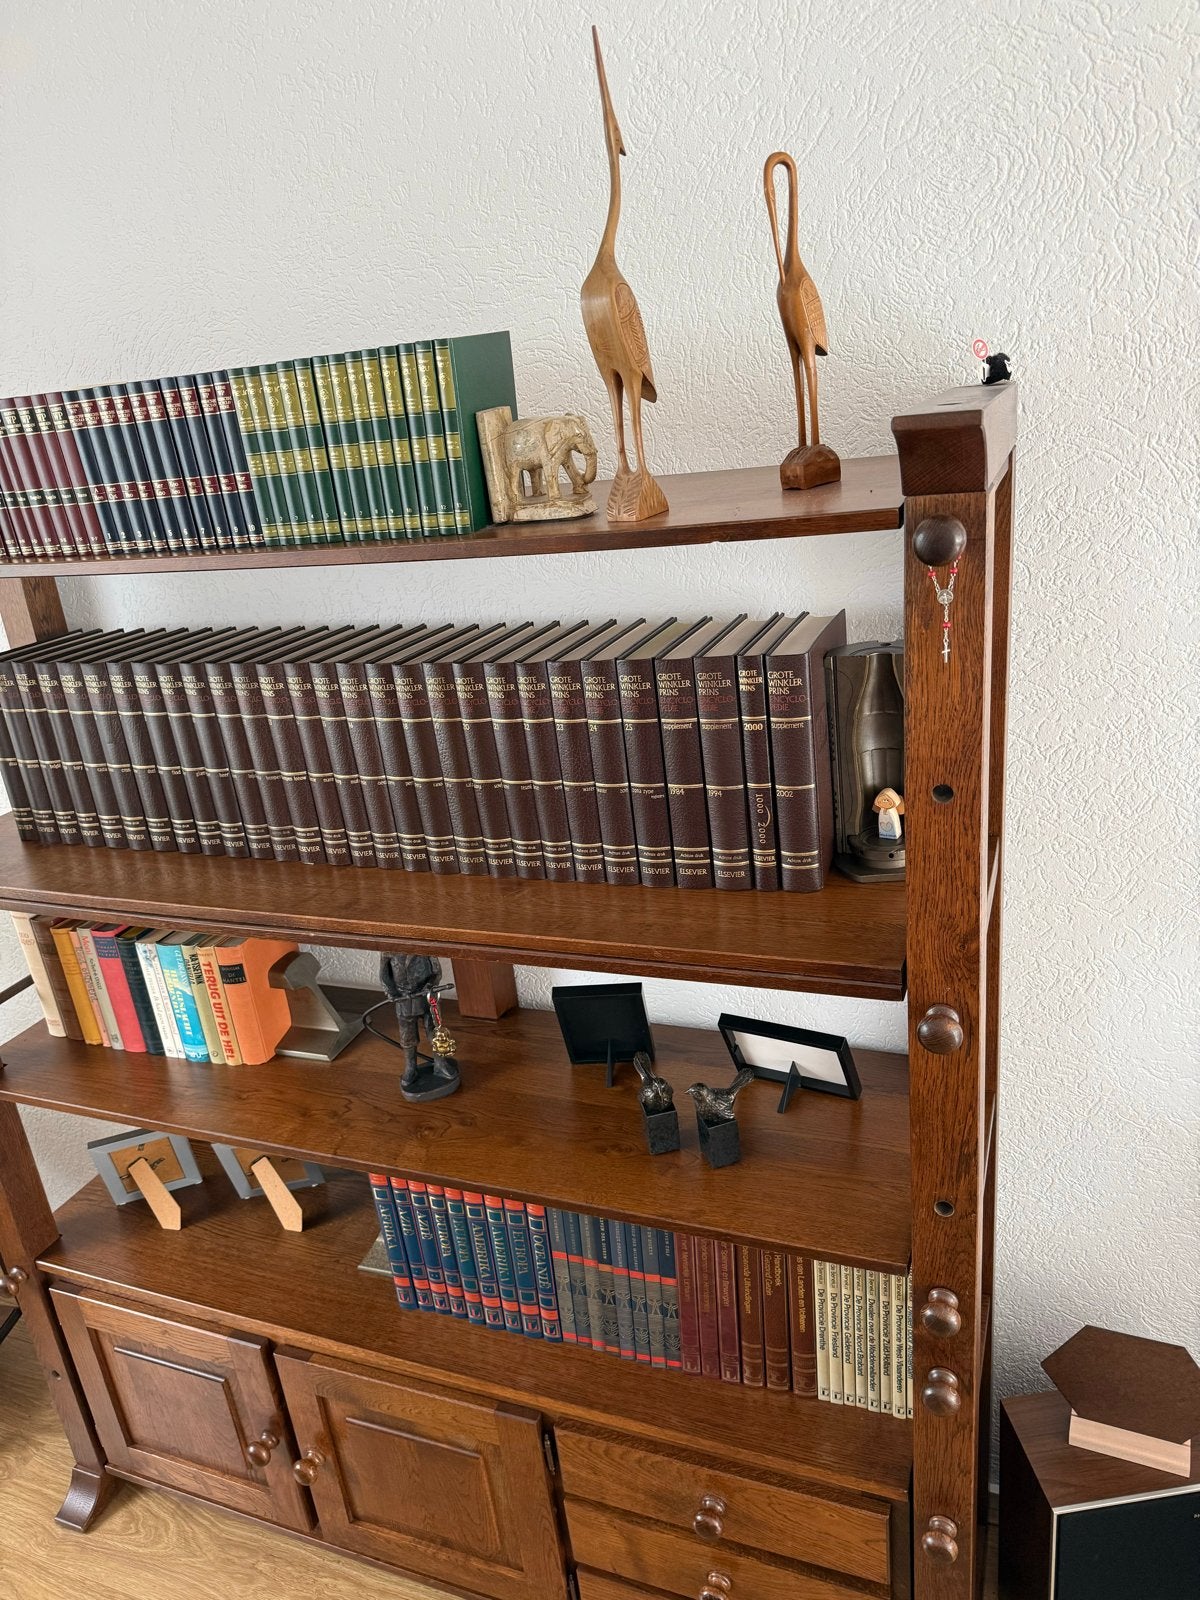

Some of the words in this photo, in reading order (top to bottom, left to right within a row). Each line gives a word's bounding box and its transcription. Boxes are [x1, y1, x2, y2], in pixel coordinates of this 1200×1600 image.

[248, 524, 255, 532] 10
[137, 530, 142, 538] 3
[657, 672, 682, 681] GROTE
[696, 672, 723, 680] GROTE
[738, 669, 758, 677] GROTE
[767, 670, 794, 679] GROTE
[549, 676, 572, 684] GROTE
[583, 676, 606, 684] GROTE
[658, 680, 691, 689] WINKLER
[697, 679, 732, 688] WINKLER
[739, 676, 763, 684] WINKLER
[768, 678, 803, 687] WINKLER
[551, 683, 581, 691] WINKLER
[585, 683, 616, 691] WINKLER
[620, 682, 652, 690] WINKLER
[740, 684, 756, 692] PRINS
[769, 687, 790, 695] PRINS
[585, 691, 604, 699] PRINS
[621, 690, 640, 698] PRINS
[659, 688, 679, 696] PRINS
[698, 688, 720, 696] PRINS
[589, 724, 598, 732] 24
[624, 723, 633, 731] 25
[701, 723, 733, 731] supplement
[743, 722, 763, 731] 2000
[771, 722, 804, 730] supplement
[708, 790, 722, 798] 1994
[776, 790, 794, 798] 2002
[755, 793, 764, 814] 1000
[757, 822, 766, 844] 2000
[576, 863, 603, 871] ELSEVIER
[607, 865, 635, 873] ELSEVIER
[642, 867, 670, 875] ELSEVIER
[679, 867, 708, 875] ELSEVIER
[717, 870, 746, 878] ELSEVIER
[202, 961, 220, 1000] TERUG
[213, 1002, 227, 1022] UIT
[217, 1021, 230, 1037] DE
[222, 1039, 235, 1061] HEL
[379, 1204, 397, 1249] AFRIKA
[416, 1210, 434, 1240] AZIË
[434, 1213, 452, 1257] EUROPA
[471, 1222, 491, 1279] AMERIKA
[491, 1226, 510, 1282] AMERIKA
[512, 1231, 529, 1275] EUROPA
[532, 1234, 551, 1289] OCEANIË
[764, 1254, 772, 1279] Gezond
[774, 1254, 782, 1287] Handboek
[796, 1263, 804, 1275] van
[764, 1278, 773, 1296] Gezin
[797, 1275, 805, 1299] Landen
[743, 1277, 752, 1314] Uitvindingen
[818, 1288, 826, 1298] De
[830, 1292, 838, 1302] De
[843, 1293, 851, 1303] De
[798, 1299, 805, 1307] en
[855, 1295, 863, 1305] De
[882, 1300, 890, 1310] De
[818, 1298, 827, 1326] Provincie
[868, 1298, 876, 1321] Dwalen
[895, 1304, 903, 1314] De
[798, 1307, 806, 1333] Volkeren
[830, 1302, 839, 1330] Provincie
[843, 1303, 852, 1331] Provincie
[855, 1305, 863, 1333] Provincie
[882, 1310, 890, 1338] Provincie
[895, 1314, 904, 1343] Provincie
[819, 1326, 827, 1351] Drenthe
[868, 1335, 876, 1344] de
[832, 1330, 840, 1359] Friesland
[844, 1332, 852, 1365] Gelderland
[856, 1333, 864, 1377] Noord-Brabant
[883, 1338, 891, 1376] Zuid-Holland
[869, 1344, 877, 1392] Waddeneilanden
[895, 1343, 904, 1393] West-Vlaanderen
